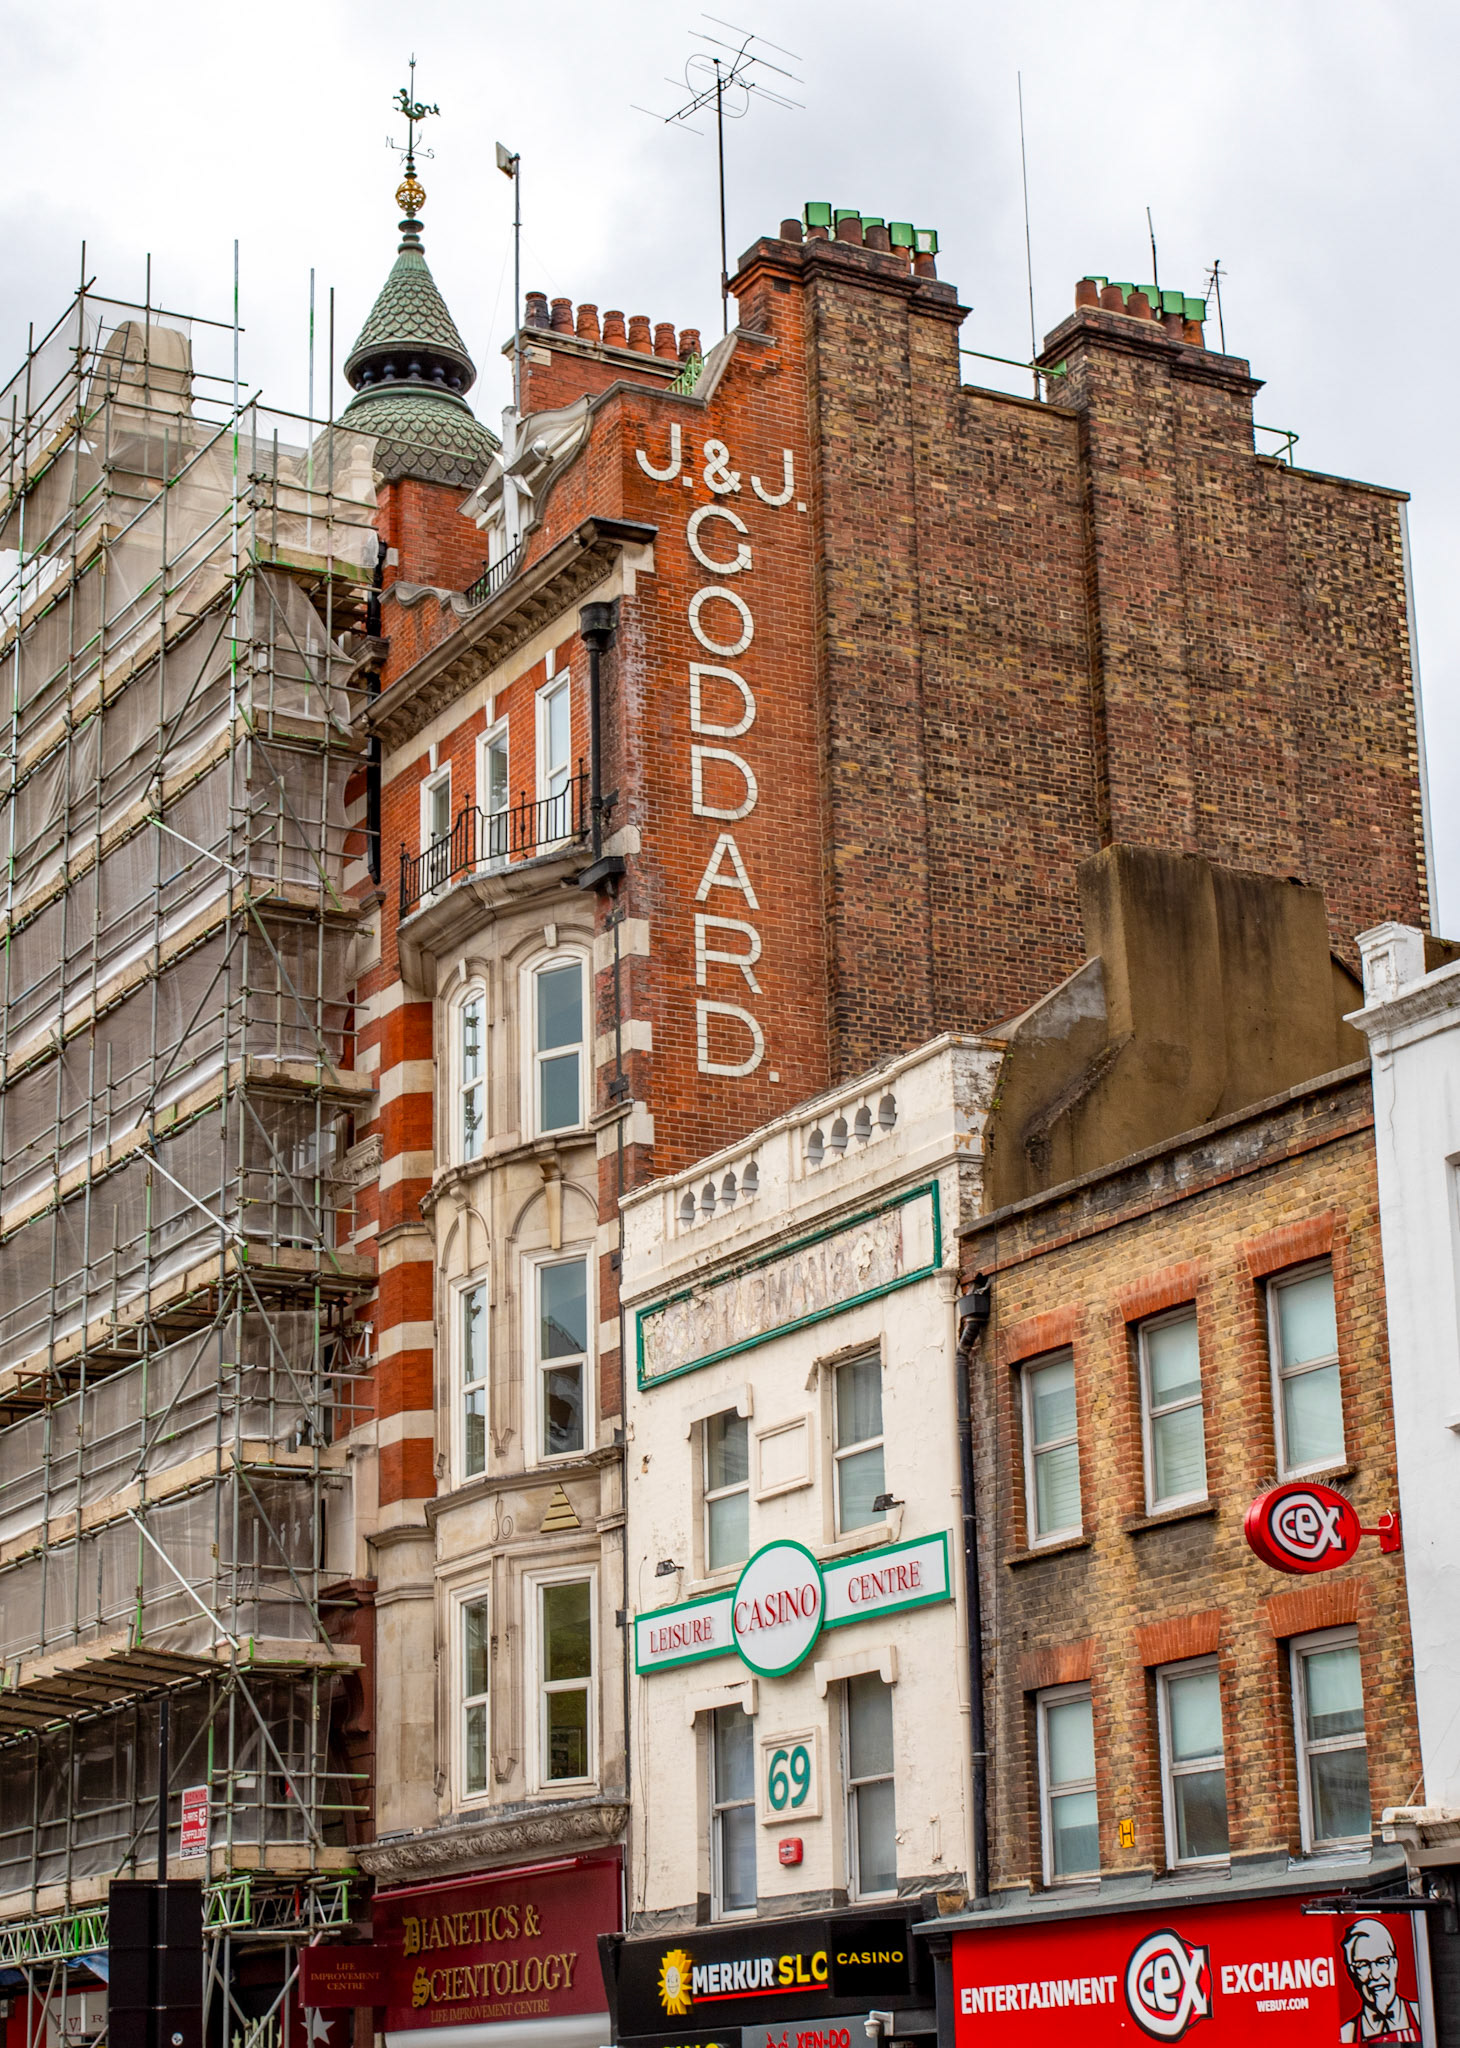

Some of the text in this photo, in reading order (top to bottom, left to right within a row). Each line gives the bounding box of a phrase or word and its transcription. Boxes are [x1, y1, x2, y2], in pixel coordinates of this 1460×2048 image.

[703, 439, 742, 494] &
[650, 1560, 921, 1653] LEISURE CASINO CENTRE
[768, 1745, 811, 1811] 69
[402, 1904, 541, 1957] DIANETICS &
[310, 1972, 380, 1981] IMPROVEMENT
[336, 1962, 356, 1971] LIFE
[692, 1957, 775, 1995] MERKUR
[836, 1950, 904, 1965] CASINO
[326, 1982, 365, 1990] CENTRE
[411, 1951, 577, 2008] SCIENTOLOGY
[961, 1975, 1118, 2015] ENTERTAINMENT
[430, 1999, 550, 2023] LIFE IMPROVEMENT CENTRE
[1256, 1997, 1309, 2013] WEBUY.COM
